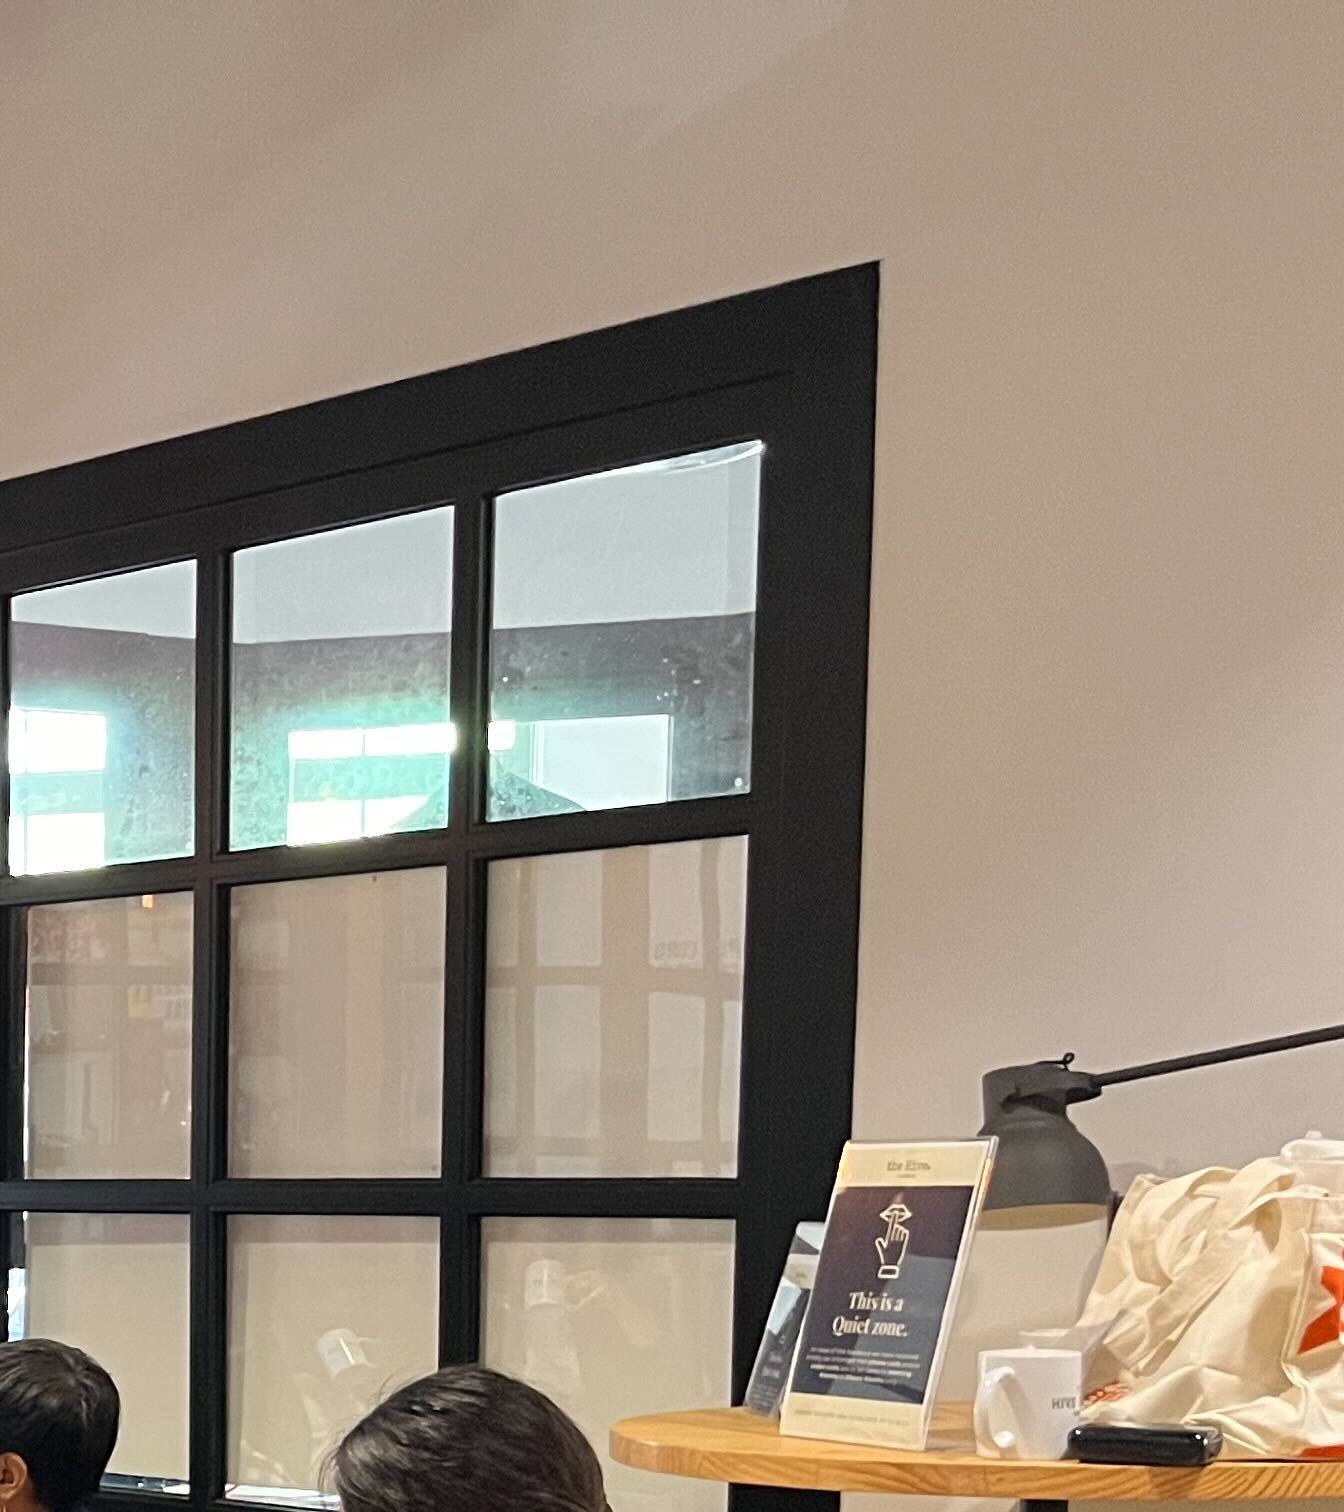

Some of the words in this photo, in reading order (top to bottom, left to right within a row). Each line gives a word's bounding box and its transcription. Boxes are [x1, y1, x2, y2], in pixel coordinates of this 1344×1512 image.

[849, 1291, 877, 1311] This
[880, 1292, 892, 1312] is
[894, 1297, 904, 1311] a
[832, 1315, 871, 1336] Quiet
[871, 1321, 908, 1337] zone.
